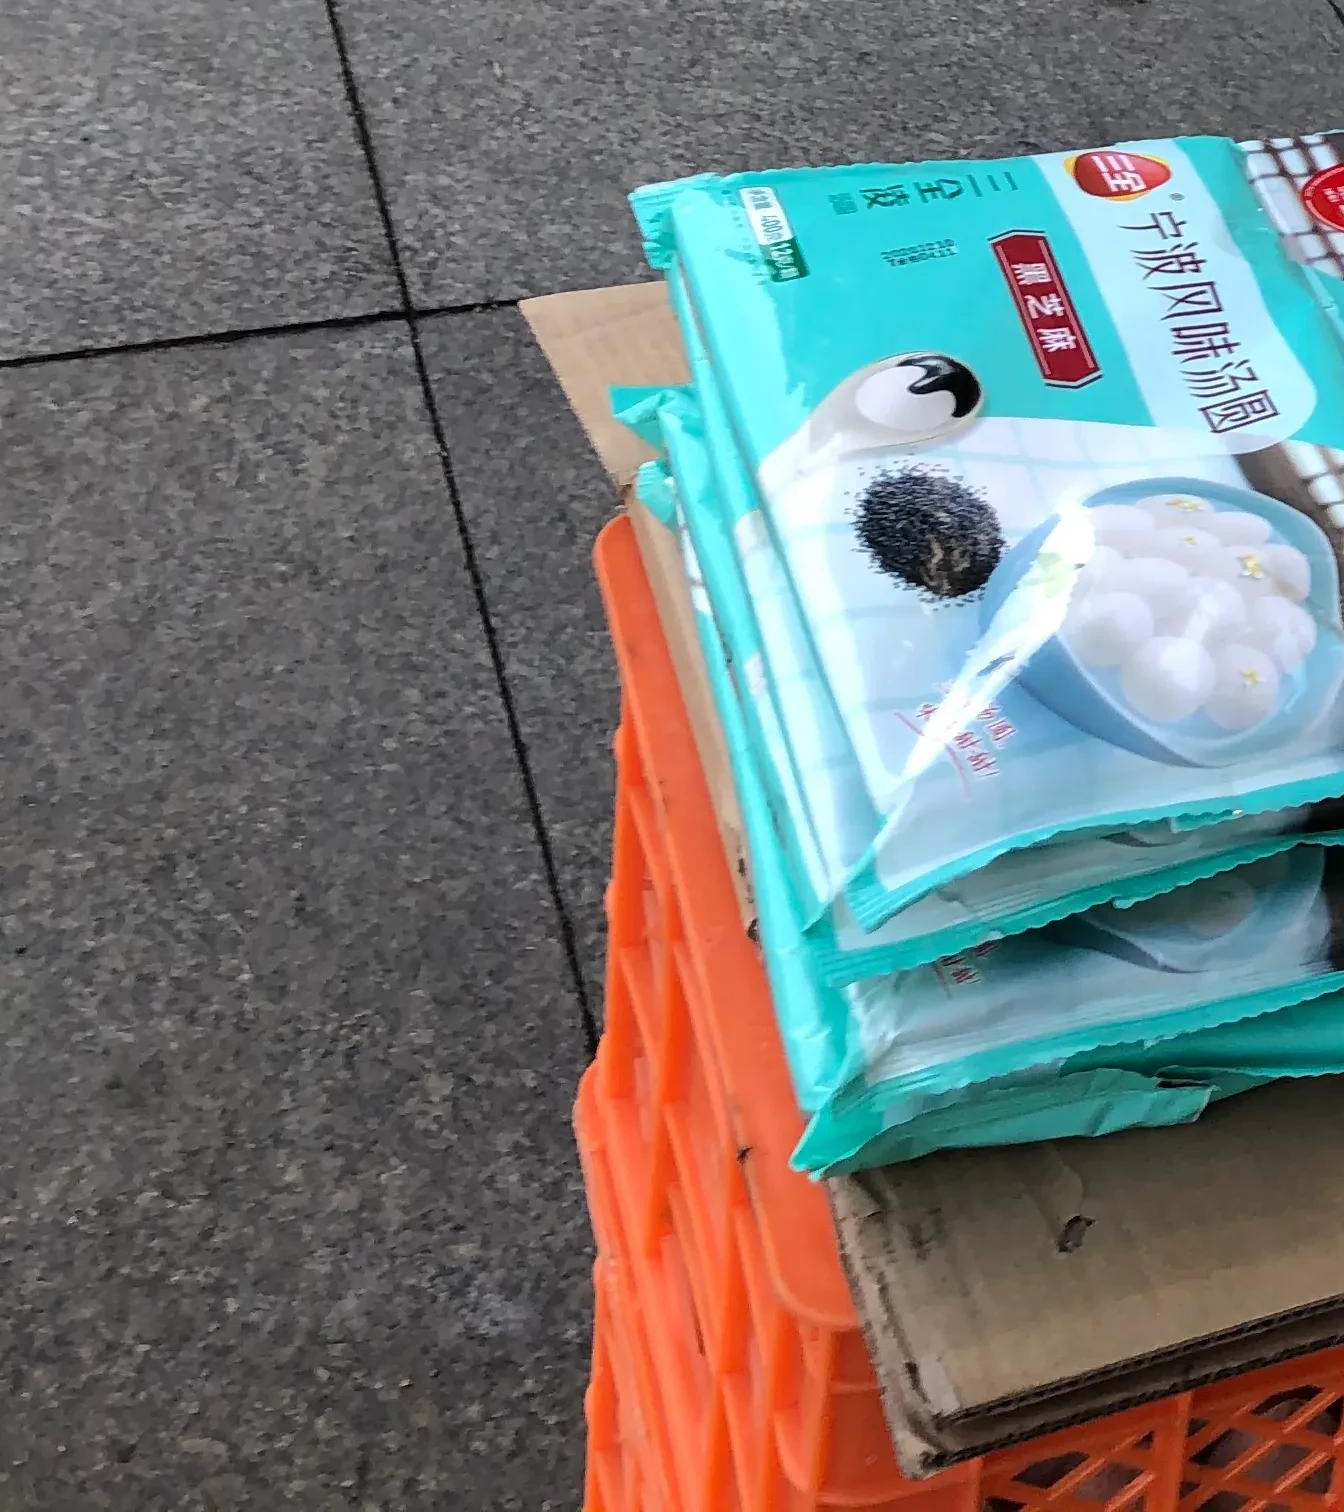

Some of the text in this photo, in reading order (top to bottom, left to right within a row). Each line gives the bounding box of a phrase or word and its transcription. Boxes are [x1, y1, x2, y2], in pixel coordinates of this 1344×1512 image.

[1091, 153, 1146, 194] 三全
[1011, 262, 1078, 352] 黑芝麻
[1120, 210, 1282, 434] 宁波风味汤圆
